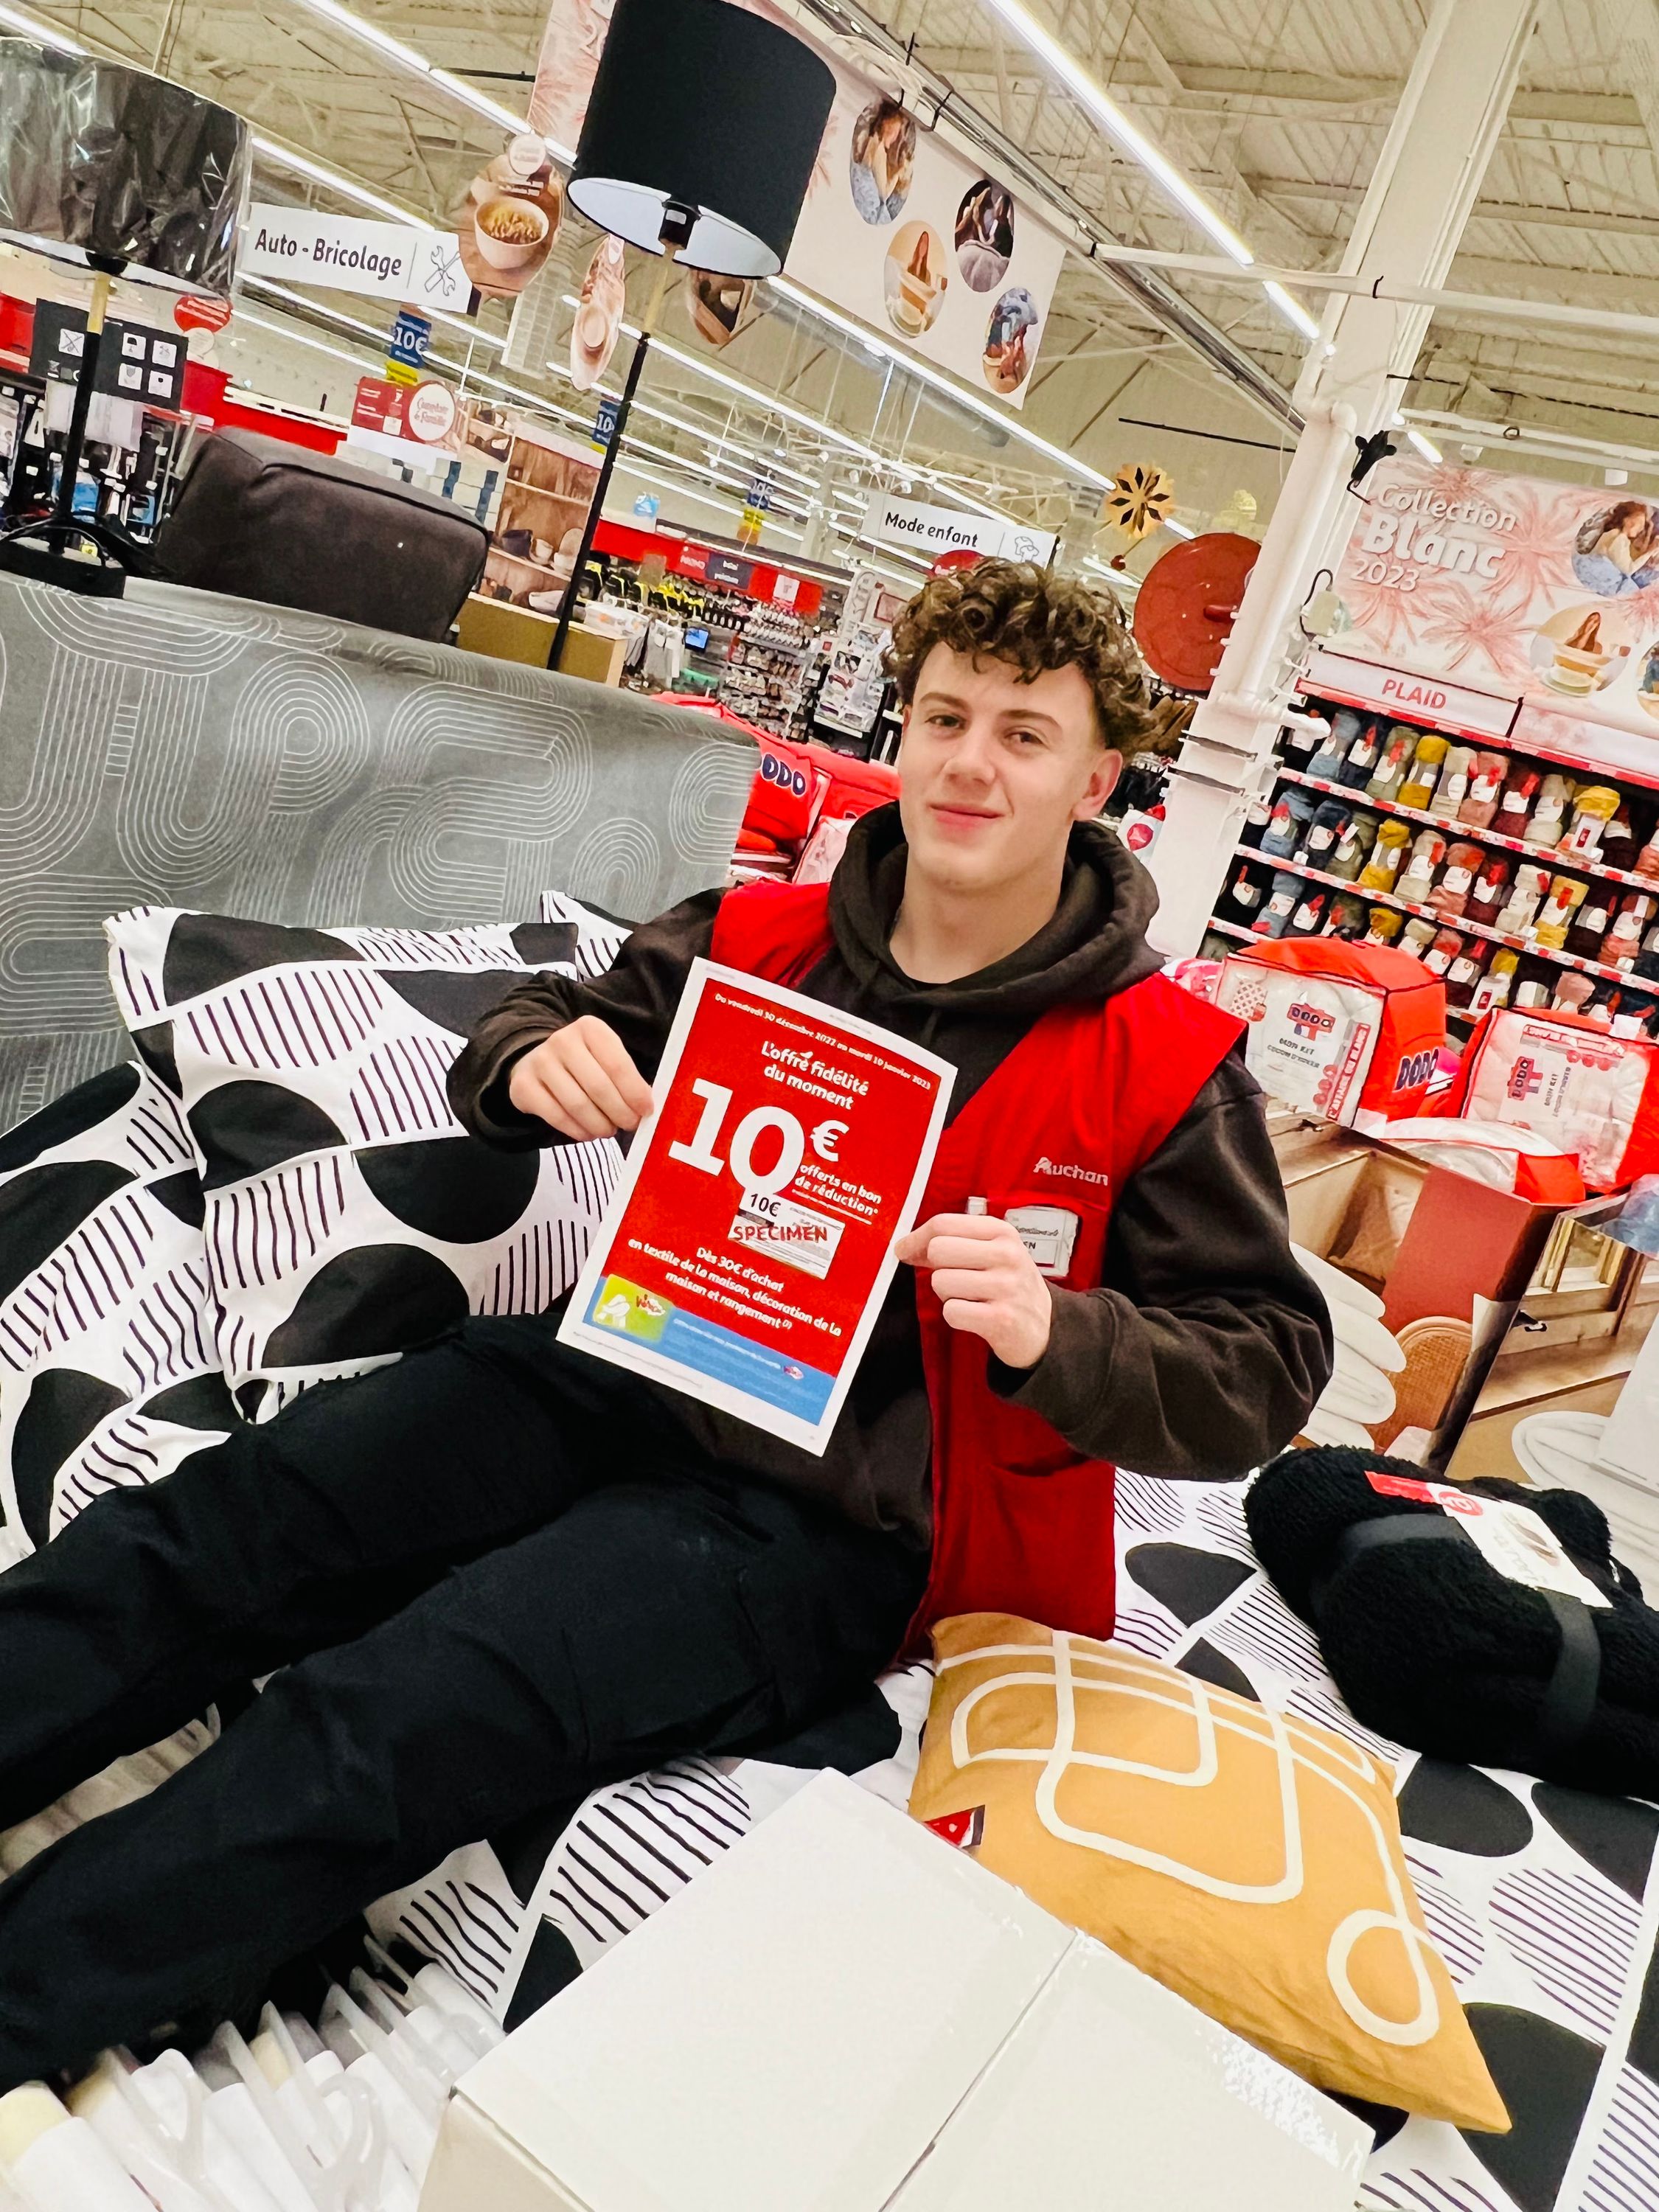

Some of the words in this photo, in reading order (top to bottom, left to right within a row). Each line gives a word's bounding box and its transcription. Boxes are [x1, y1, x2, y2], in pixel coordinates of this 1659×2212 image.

[254, 229, 297, 257] Auto
[313, 238, 401, 281] Bricolage
[597, 413, 615, 433] 10
[1378, 484, 1517, 531] Collection
[885, 512, 925, 534] Mode
[928, 526, 978, 548] enfant
[1362, 512, 1506, 578] Blanc
[1351, 558, 1420, 591] 2023
[1382, 679, 1447, 709] PLAID
[762, 752, 806, 797] ODO
[1292, 1007, 1331, 1027] DODO
[815, 1032, 836, 1046] 2022
[764, 1064, 786, 1082] du
[787, 1075, 854, 1110] moment
[810, 1060, 869, 1096] fidélité
[1392, 1047, 1439, 1093] DODO
[1512, 1060, 1529, 1098] DODO
[795, 1176, 811, 1189] de
[800, 1165, 841, 1187] offerts
[841, 1182, 857, 1194] en
[858, 1185, 882, 1204] bon
[1033, 1157, 1108, 1186] Auchan
[751, 1193, 782, 1217] 10€
[734, 1226, 827, 1243] SPECIMEN
[628, 1239, 642, 1250] en
[644, 1243, 681, 1266] textile
[680, 1259, 695, 1273] de
[695, 1264, 708, 1278] la
[708, 1273, 751, 1299] maison,
[752, 1291, 813, 1324] décoration
[814, 1318, 829, 1332] de
[829, 1322, 842, 1337] la
[696, 1247, 717, 1264] Dès
[717, 1256, 743, 1274] 30€
[742, 1268, 785, 1293] d'achat
[665, 1273, 706, 1295] maison
[707, 1290, 720, 1301] et
[720, 1295, 781, 1329] rangement
